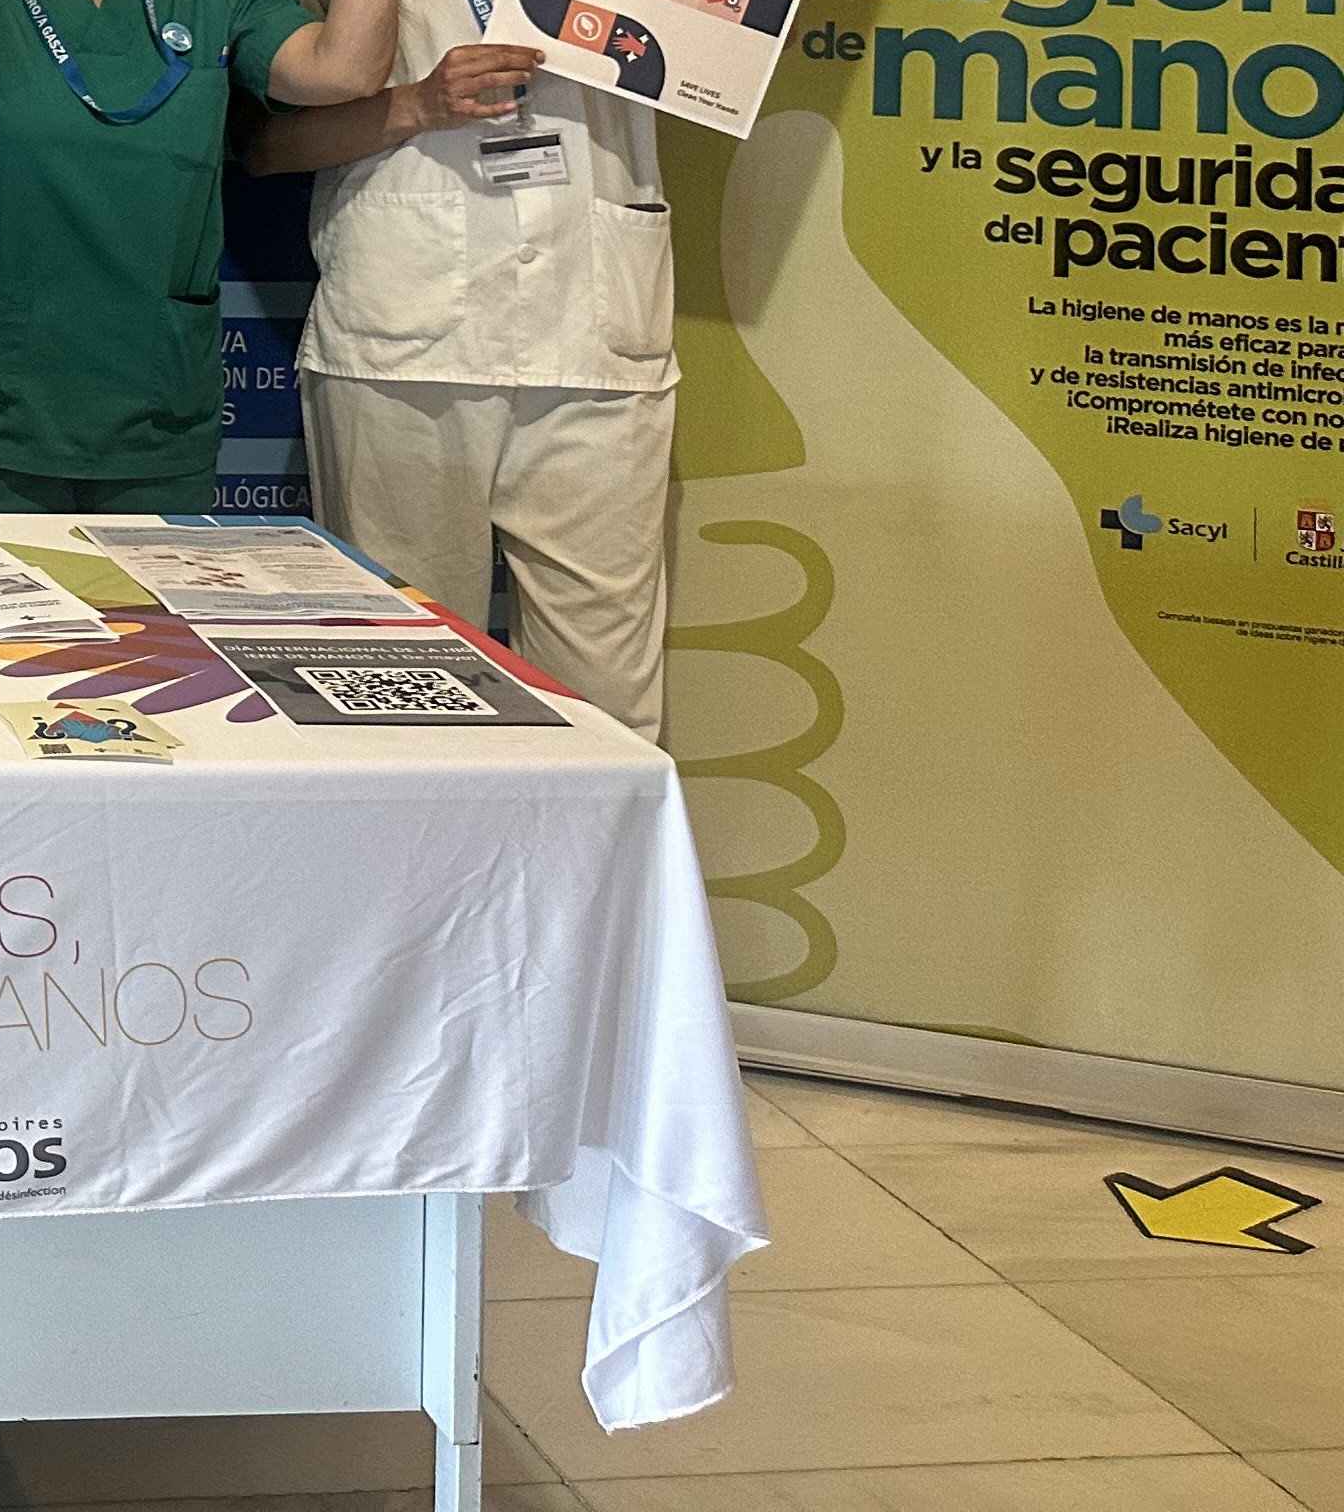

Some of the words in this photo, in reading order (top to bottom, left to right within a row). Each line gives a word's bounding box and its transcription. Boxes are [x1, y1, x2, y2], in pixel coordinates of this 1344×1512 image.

[803, 22, 865, 62] de
[873, 26, 1344, 140] mano
[920, 146, 943, 172] y
[953, 142, 982, 171] la
[984, 216, 1043, 246] del
[1053, 213, 1344, 282] pacien
[1029, 296, 1055, 315] La
[1062, 298, 1144, 322] higiene
[1151, 306, 1181, 324] de
[1188, 311, 1268, 331] manos
[1164, 330, 1213, 349] más
[1220, 334, 1290, 355] eficaz
[1109, 348, 1246, 375] transmisión
[1253, 358, 1284, 377] de
[1051, 366, 1079, 385] de
[1086, 369, 1220, 396] resistencias
[1068, 390, 1255, 421] ¡Comprométete
[1262, 408, 1306, 425] con
[1107, 416, 1198, 440] ¡Realiza
[1206, 423, 1294, 447] higiene
[1168, 518, 1228, 542] Sacyl
